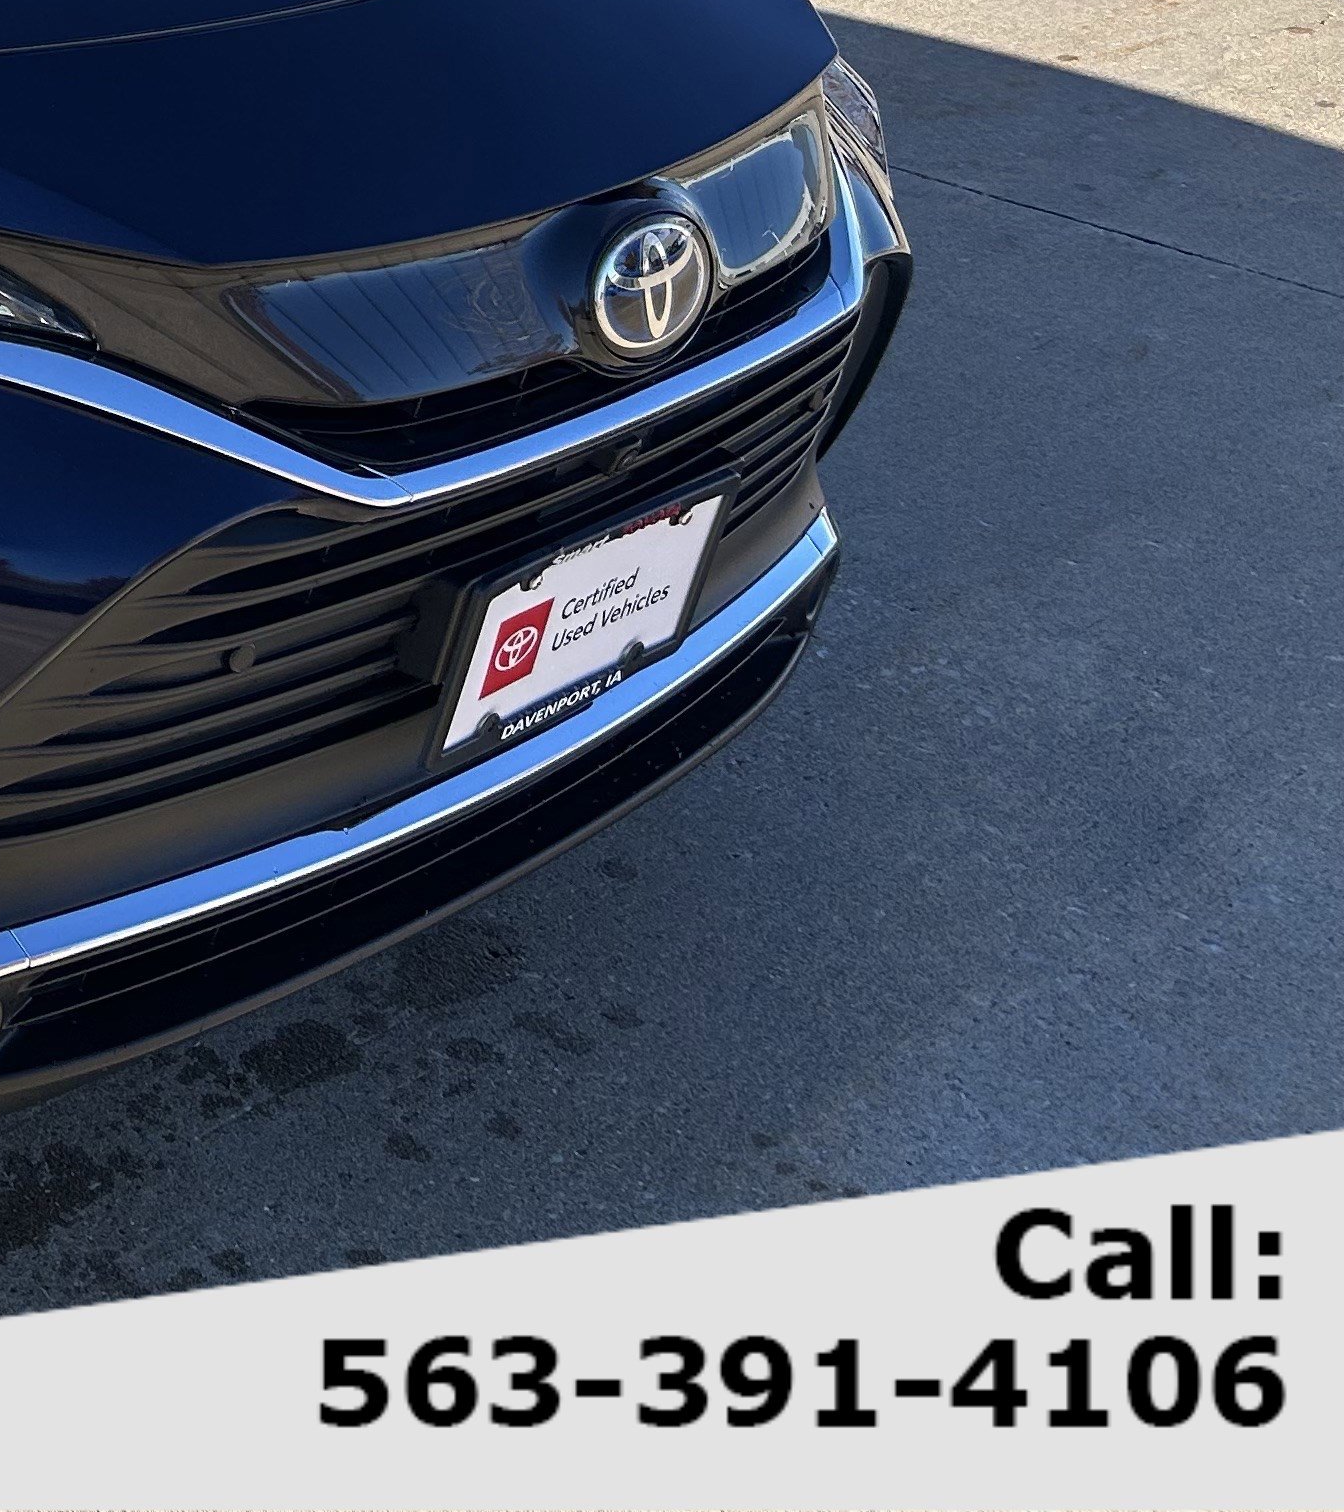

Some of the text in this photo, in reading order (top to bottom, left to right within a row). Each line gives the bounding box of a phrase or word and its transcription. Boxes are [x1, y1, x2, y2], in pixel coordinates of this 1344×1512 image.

[551, 584, 671, 652] Used Vehicles
[561, 566, 640, 620] Certified
[500, 669, 623, 740] DAVENPORT, IA
